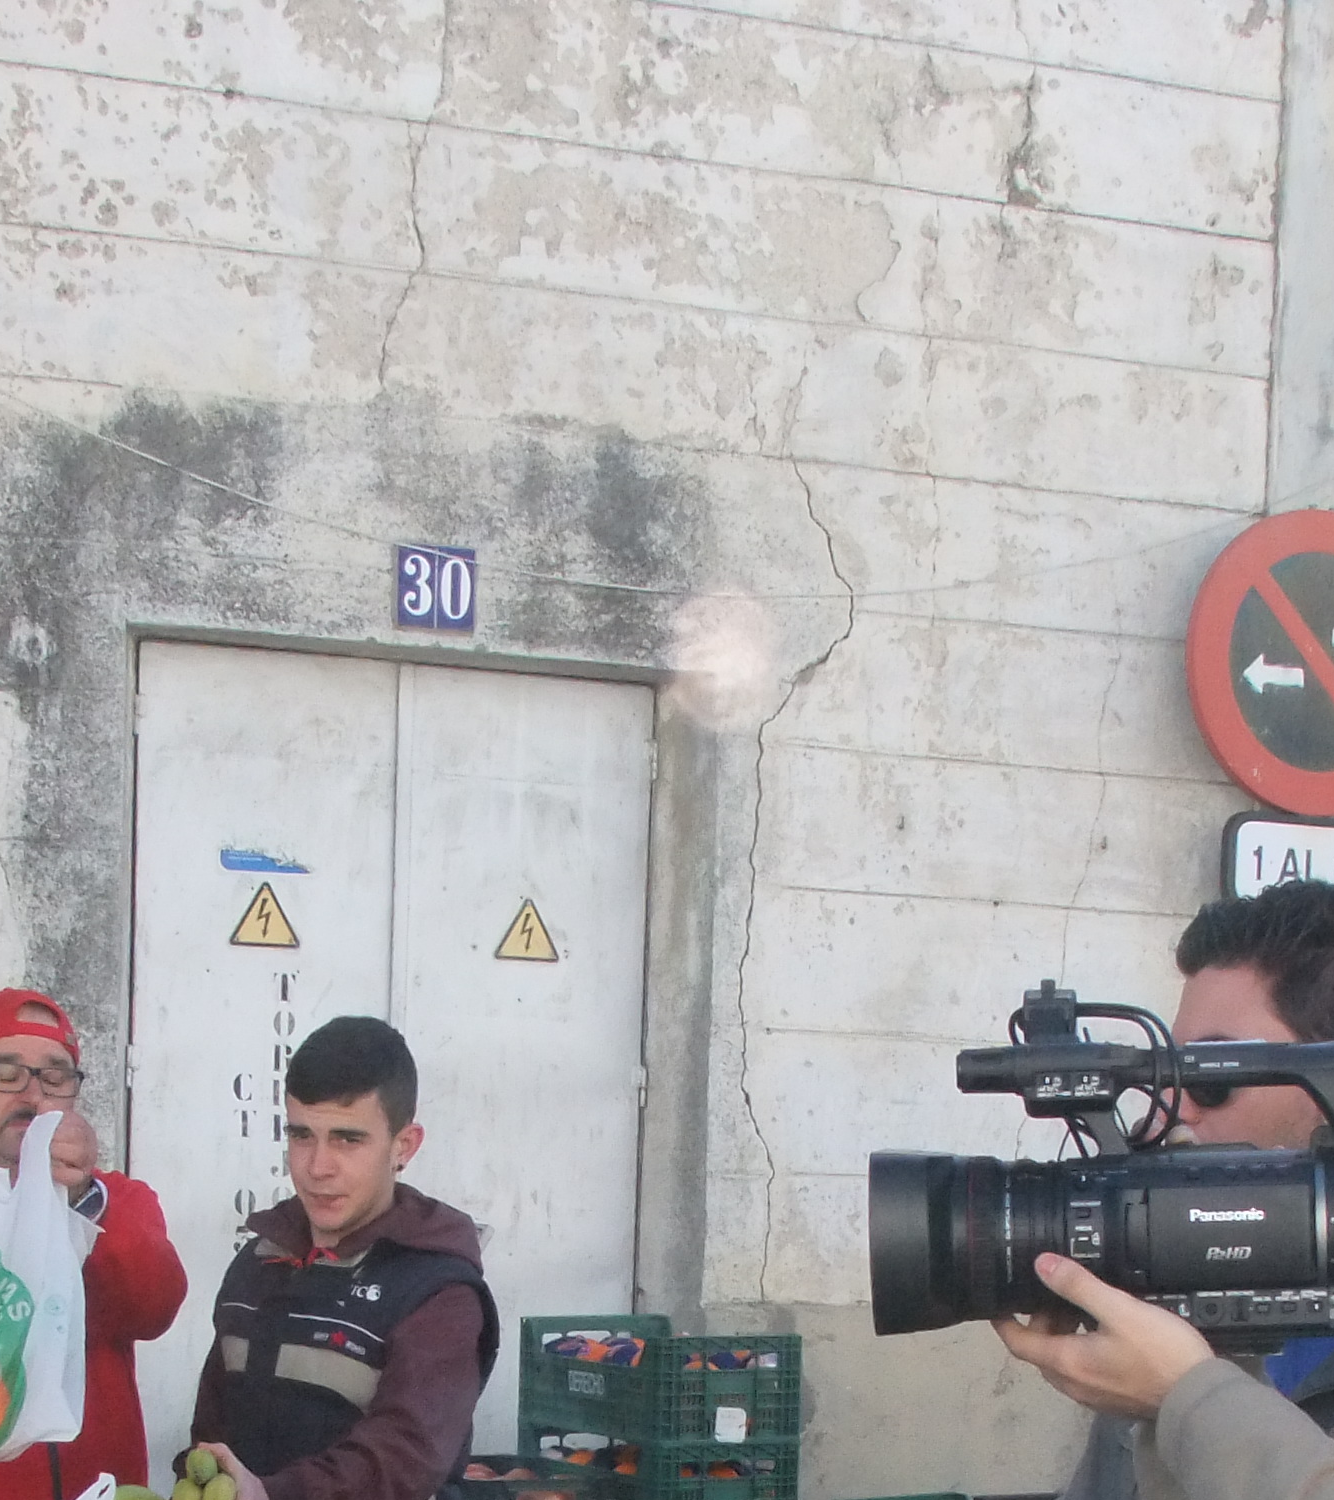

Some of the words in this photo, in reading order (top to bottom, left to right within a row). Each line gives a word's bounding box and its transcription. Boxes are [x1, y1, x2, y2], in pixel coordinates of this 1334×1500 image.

[404, 554, 471, 620] 30
[1253, 845, 1264, 880] 1
[1189, 1207, 1265, 1222] Panasonic
